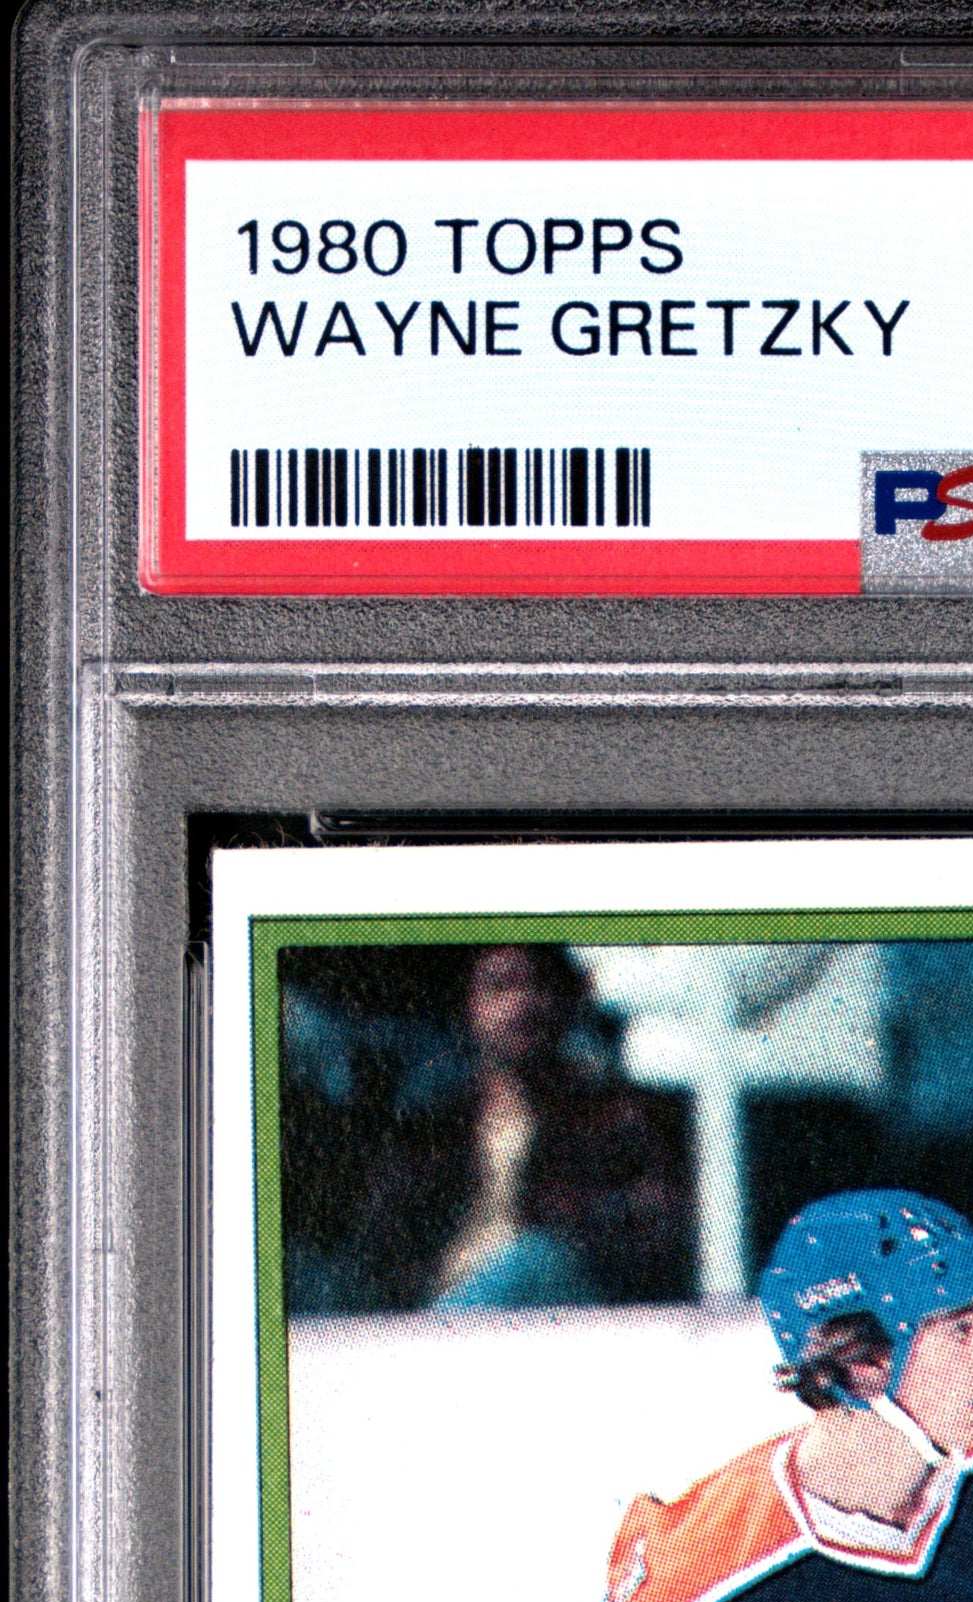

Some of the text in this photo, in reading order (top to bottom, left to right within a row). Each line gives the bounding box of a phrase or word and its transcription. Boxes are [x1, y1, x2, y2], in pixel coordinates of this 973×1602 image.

[237, 217, 684, 277] 1980 TOPPS
[230, 298, 911, 358] WAYNE GRETZKY
